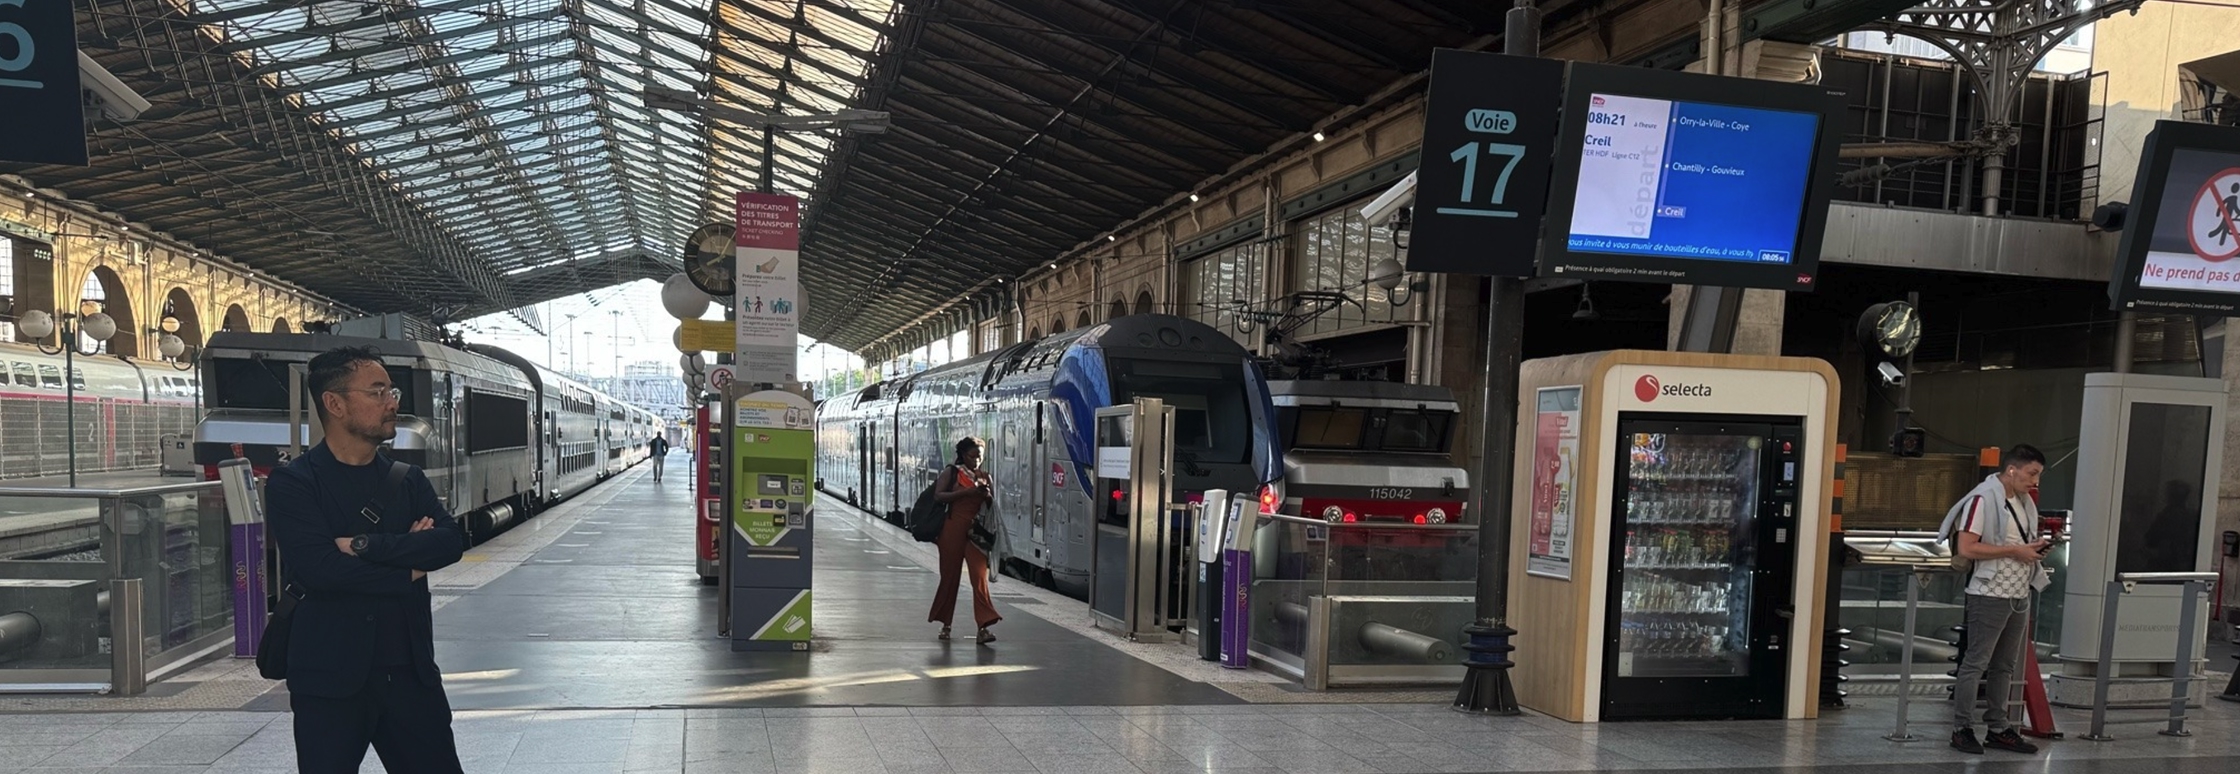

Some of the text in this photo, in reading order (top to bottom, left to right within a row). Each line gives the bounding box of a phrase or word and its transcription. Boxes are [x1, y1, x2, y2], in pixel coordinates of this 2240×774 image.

[1472, 112, 1510, 130] Voie
[1588, 112, 1626, 126] 08h21
[1680, 116, 1726, 129] Orry-la-Ville
[1731, 121, 1750, 132] Coye
[1584, 134, 1612, 146] Creil
[1612, 152, 1628, 160] Ligne
[1450, 141, 1526, 204] 17
[1672, 162, 1706, 174] Chantilly
[1712, 165, 1745, 176] Gouvieux
[1627, 145, 1658, 235] départ
[741, 201, 789, 212] VÉRIFICATION
[1664, 207, 1684, 216] Creil
[756, 211, 779, 220] TITRES
[752, 220, 794, 228] TRANSPORT
[1584, 238, 1605, 248] invite
[1606, 240, 1611, 248] à
[1630, 242, 1652, 250] munir
[1653, 243, 1663, 251] de
[1664, 244, 1700, 253] bouteilles
[1722, 247, 1728, 255] à
[1605, 266, 1632, 274] obligatoire
[2144, 263, 2164, 277] Ne
[2166, 267, 2206, 281] prend
[2206, 271, 2230, 284] pas
[1662, 383, 1712, 396] selecta
[88, 422, 94, 442] 2
[1052, 471, 1064, 484] SNCF
[1370, 488, 1412, 499] 115042
